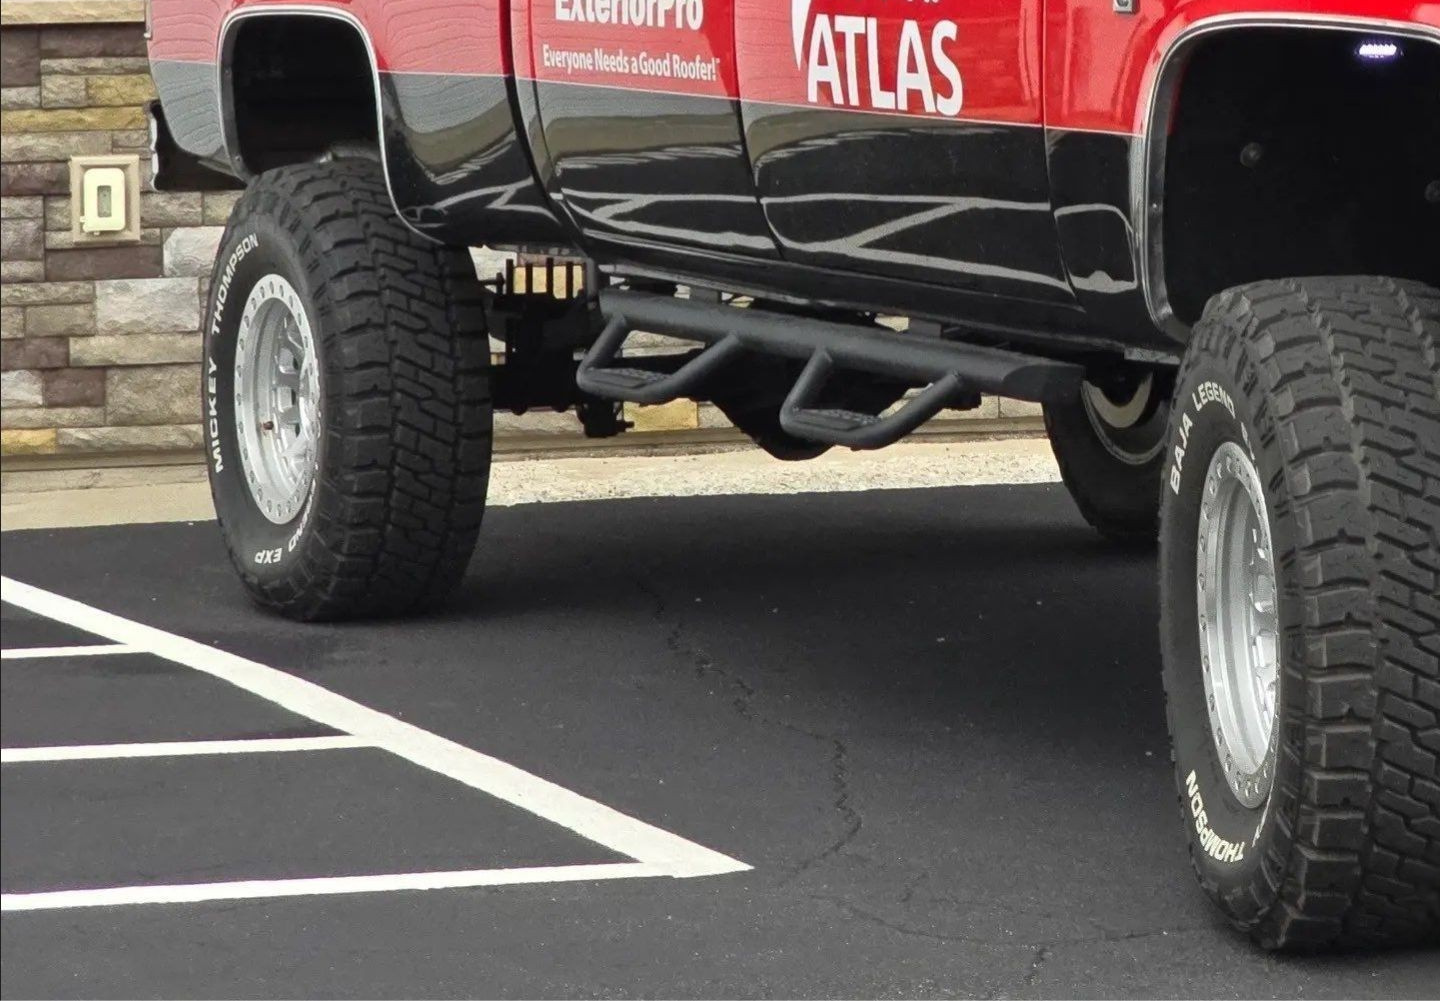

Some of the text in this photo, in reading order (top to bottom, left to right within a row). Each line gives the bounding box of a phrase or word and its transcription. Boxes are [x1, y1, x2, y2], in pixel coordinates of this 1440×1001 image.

[543, 44, 593, 74] Everyone
[594, 47, 629, 74] Needs
[631, 58, 639, 74] a
[639, 51, 670, 77] Good
[807, 13, 963, 116] ATLAS
[208, 233, 259, 474] MICKEY THOMPSON
[1170, 381, 1236, 495] BAJA LEGEND
[254, 548, 283, 564] EXP
[1185, 769, 1245, 863] THOMPSON
